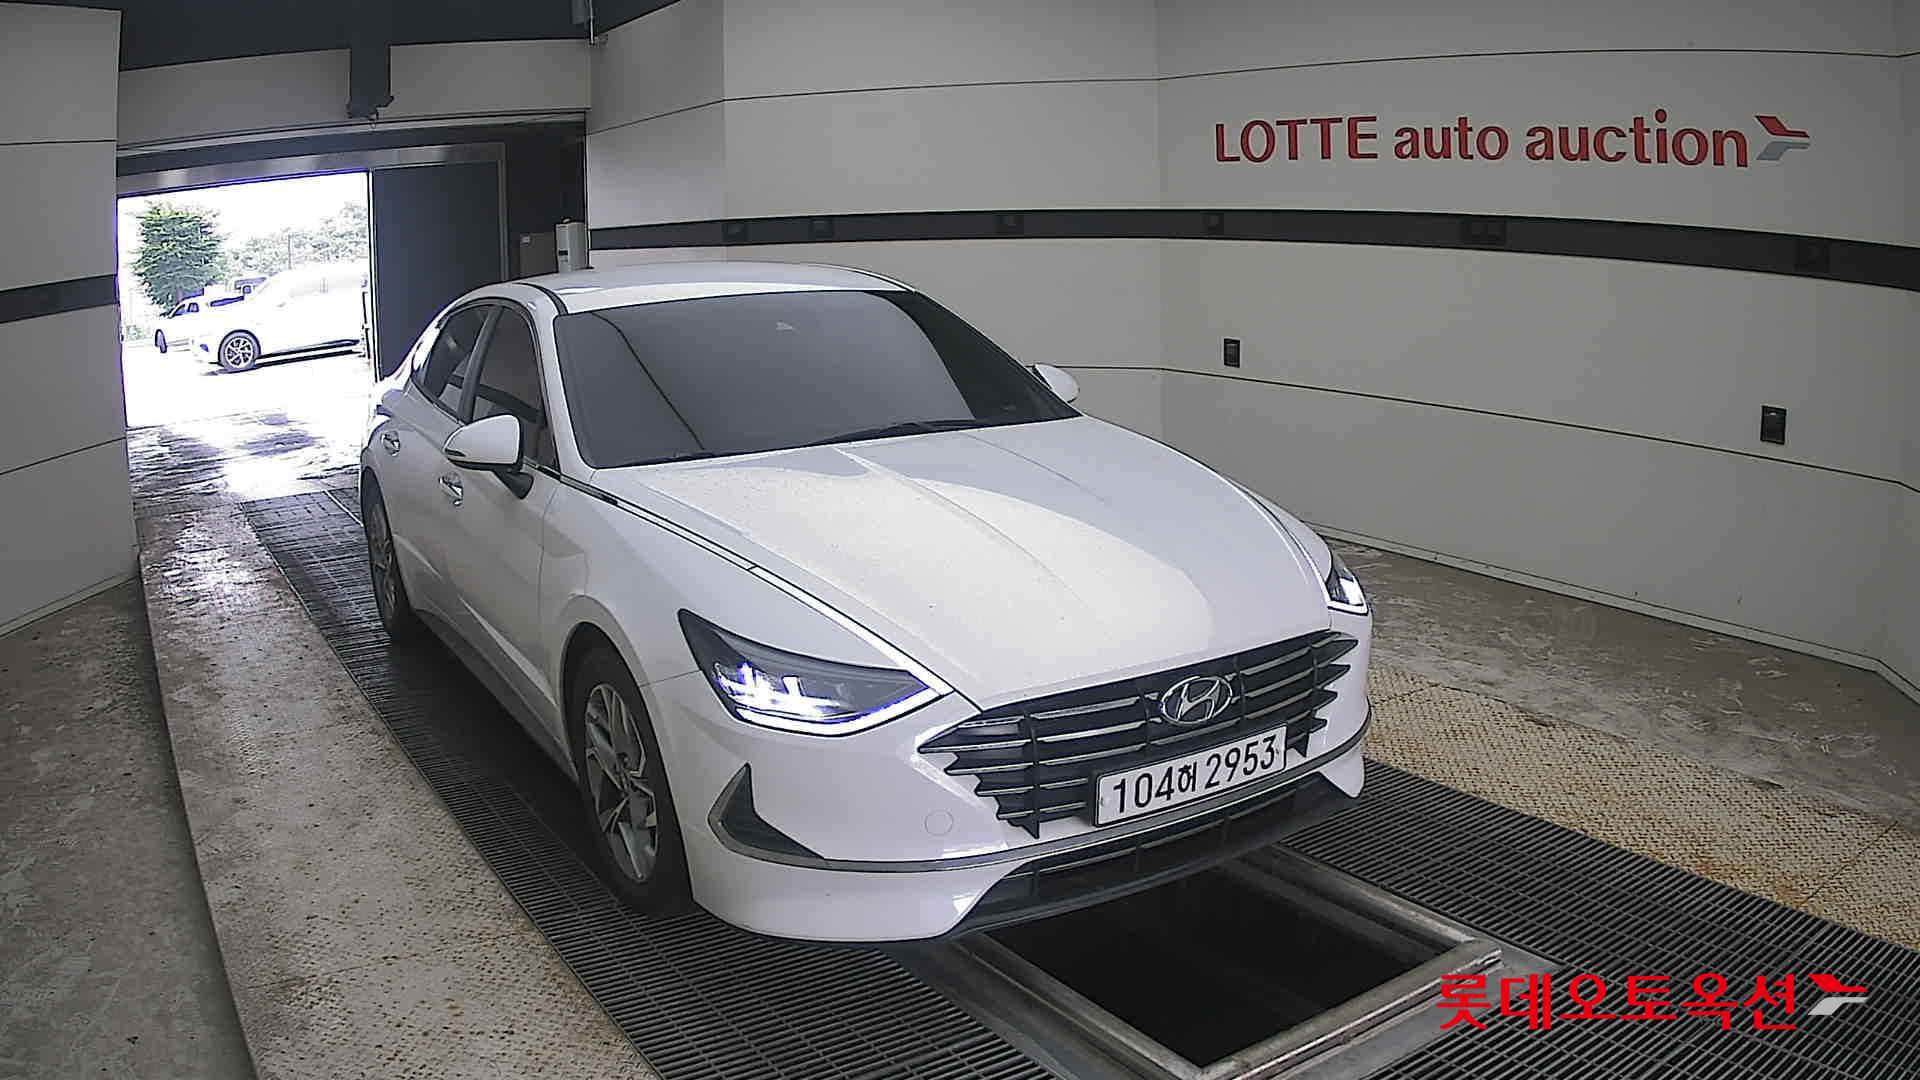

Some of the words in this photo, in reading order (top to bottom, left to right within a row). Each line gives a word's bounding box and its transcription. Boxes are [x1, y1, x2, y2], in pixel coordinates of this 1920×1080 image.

[1214, 116, 1378, 163] LOTTE
[1393, 115, 1509, 161] auto
[1524, 108, 1749, 168] auction
[1112, 762, 1198, 813] 104허
[1204, 734, 1277, 790] 2953
